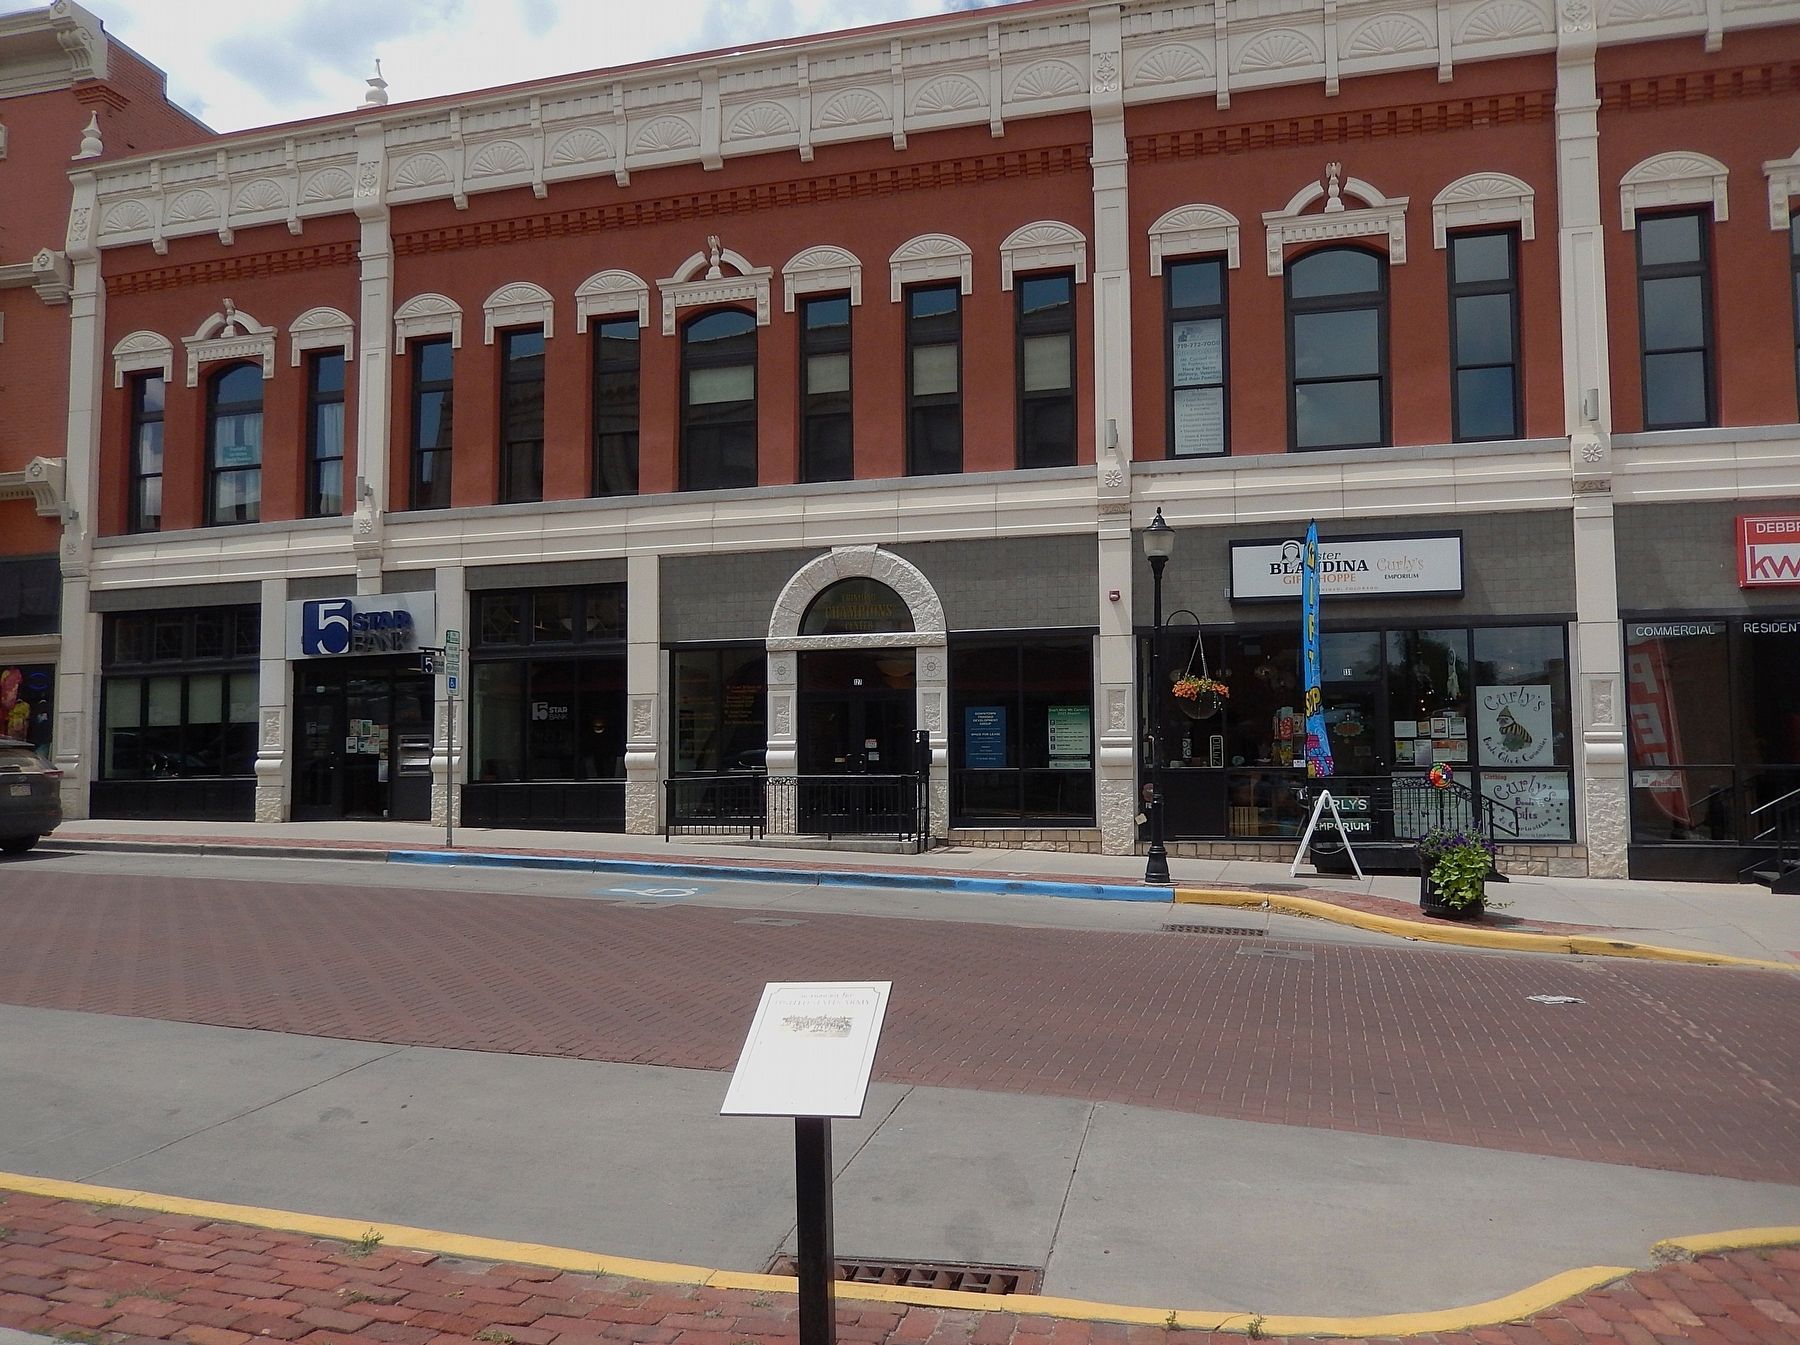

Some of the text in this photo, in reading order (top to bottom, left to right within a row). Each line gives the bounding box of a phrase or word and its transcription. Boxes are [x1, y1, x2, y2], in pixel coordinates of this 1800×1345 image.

[1269, 559, 1369, 575] BLADINA
[1376, 556, 1424, 573] Curly's
[1319, 573, 1356, 583] HOPPE
[316, 602, 349, 655] 5
[1636, 626, 1715, 636] COMMERCIAL
[425, 657, 434, 672] 5
[1484, 687, 1546, 712] Curly's
[549, 706, 568, 714] STAR
[1493, 775, 1557, 802] Curly's
